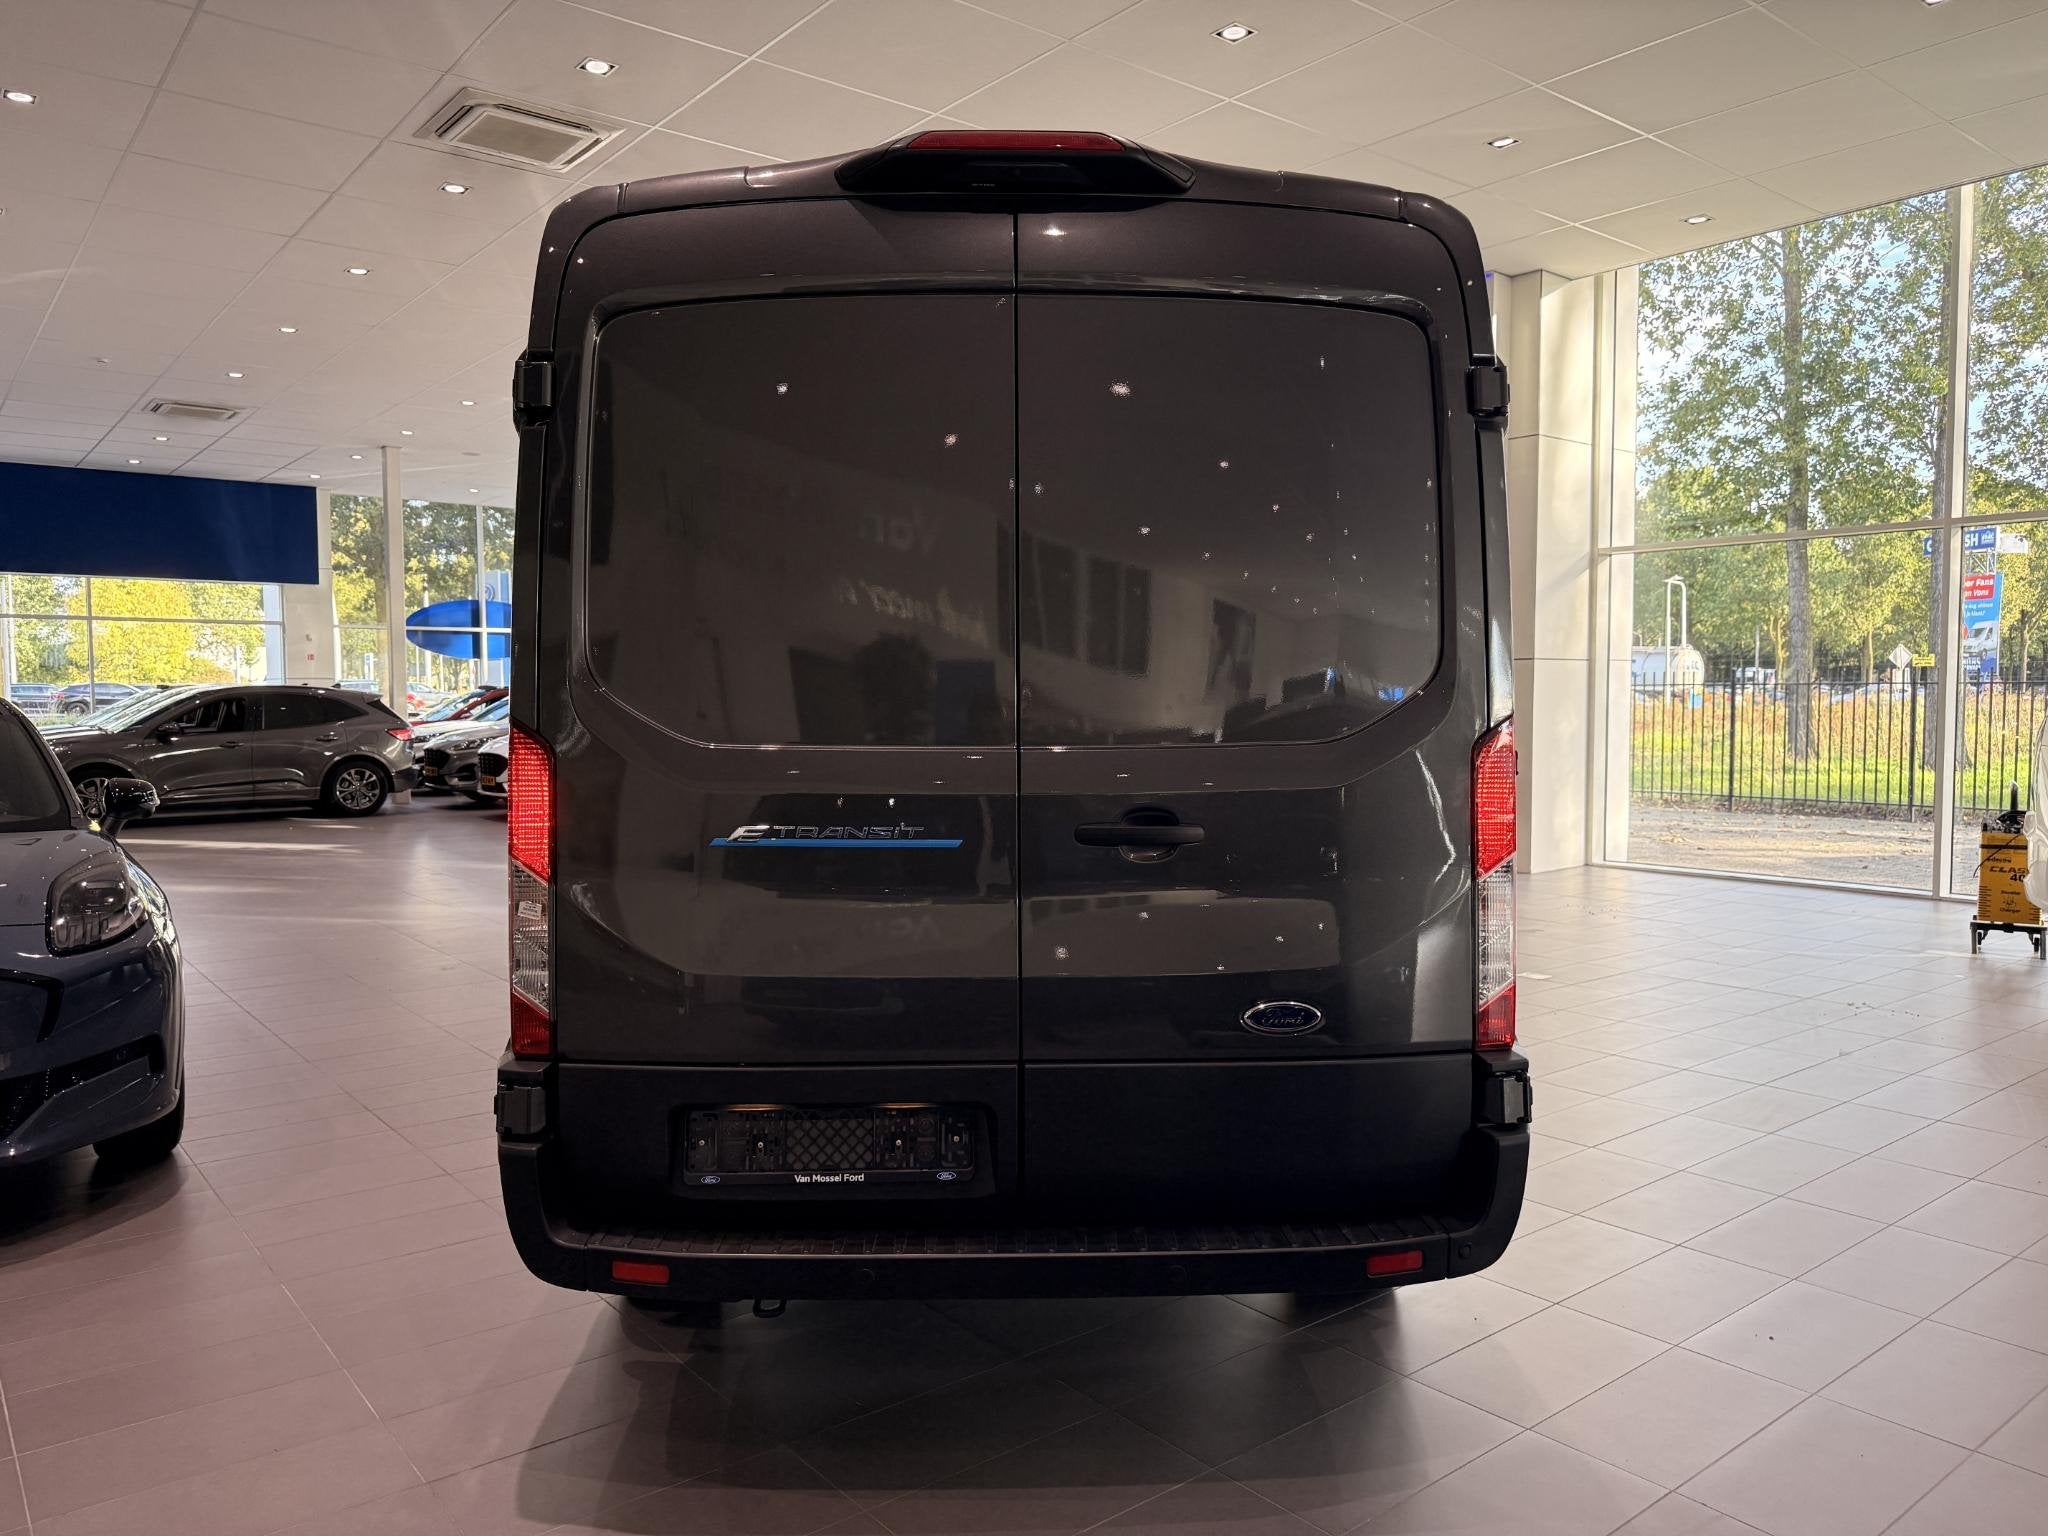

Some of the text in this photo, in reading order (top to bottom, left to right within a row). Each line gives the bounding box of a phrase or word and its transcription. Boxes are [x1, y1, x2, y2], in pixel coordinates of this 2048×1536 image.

[1965, 533, 1978, 547] SH
[1990, 866, 2029, 874] CLAS
[794, 1173, 865, 1183] Van Mossel Ford
